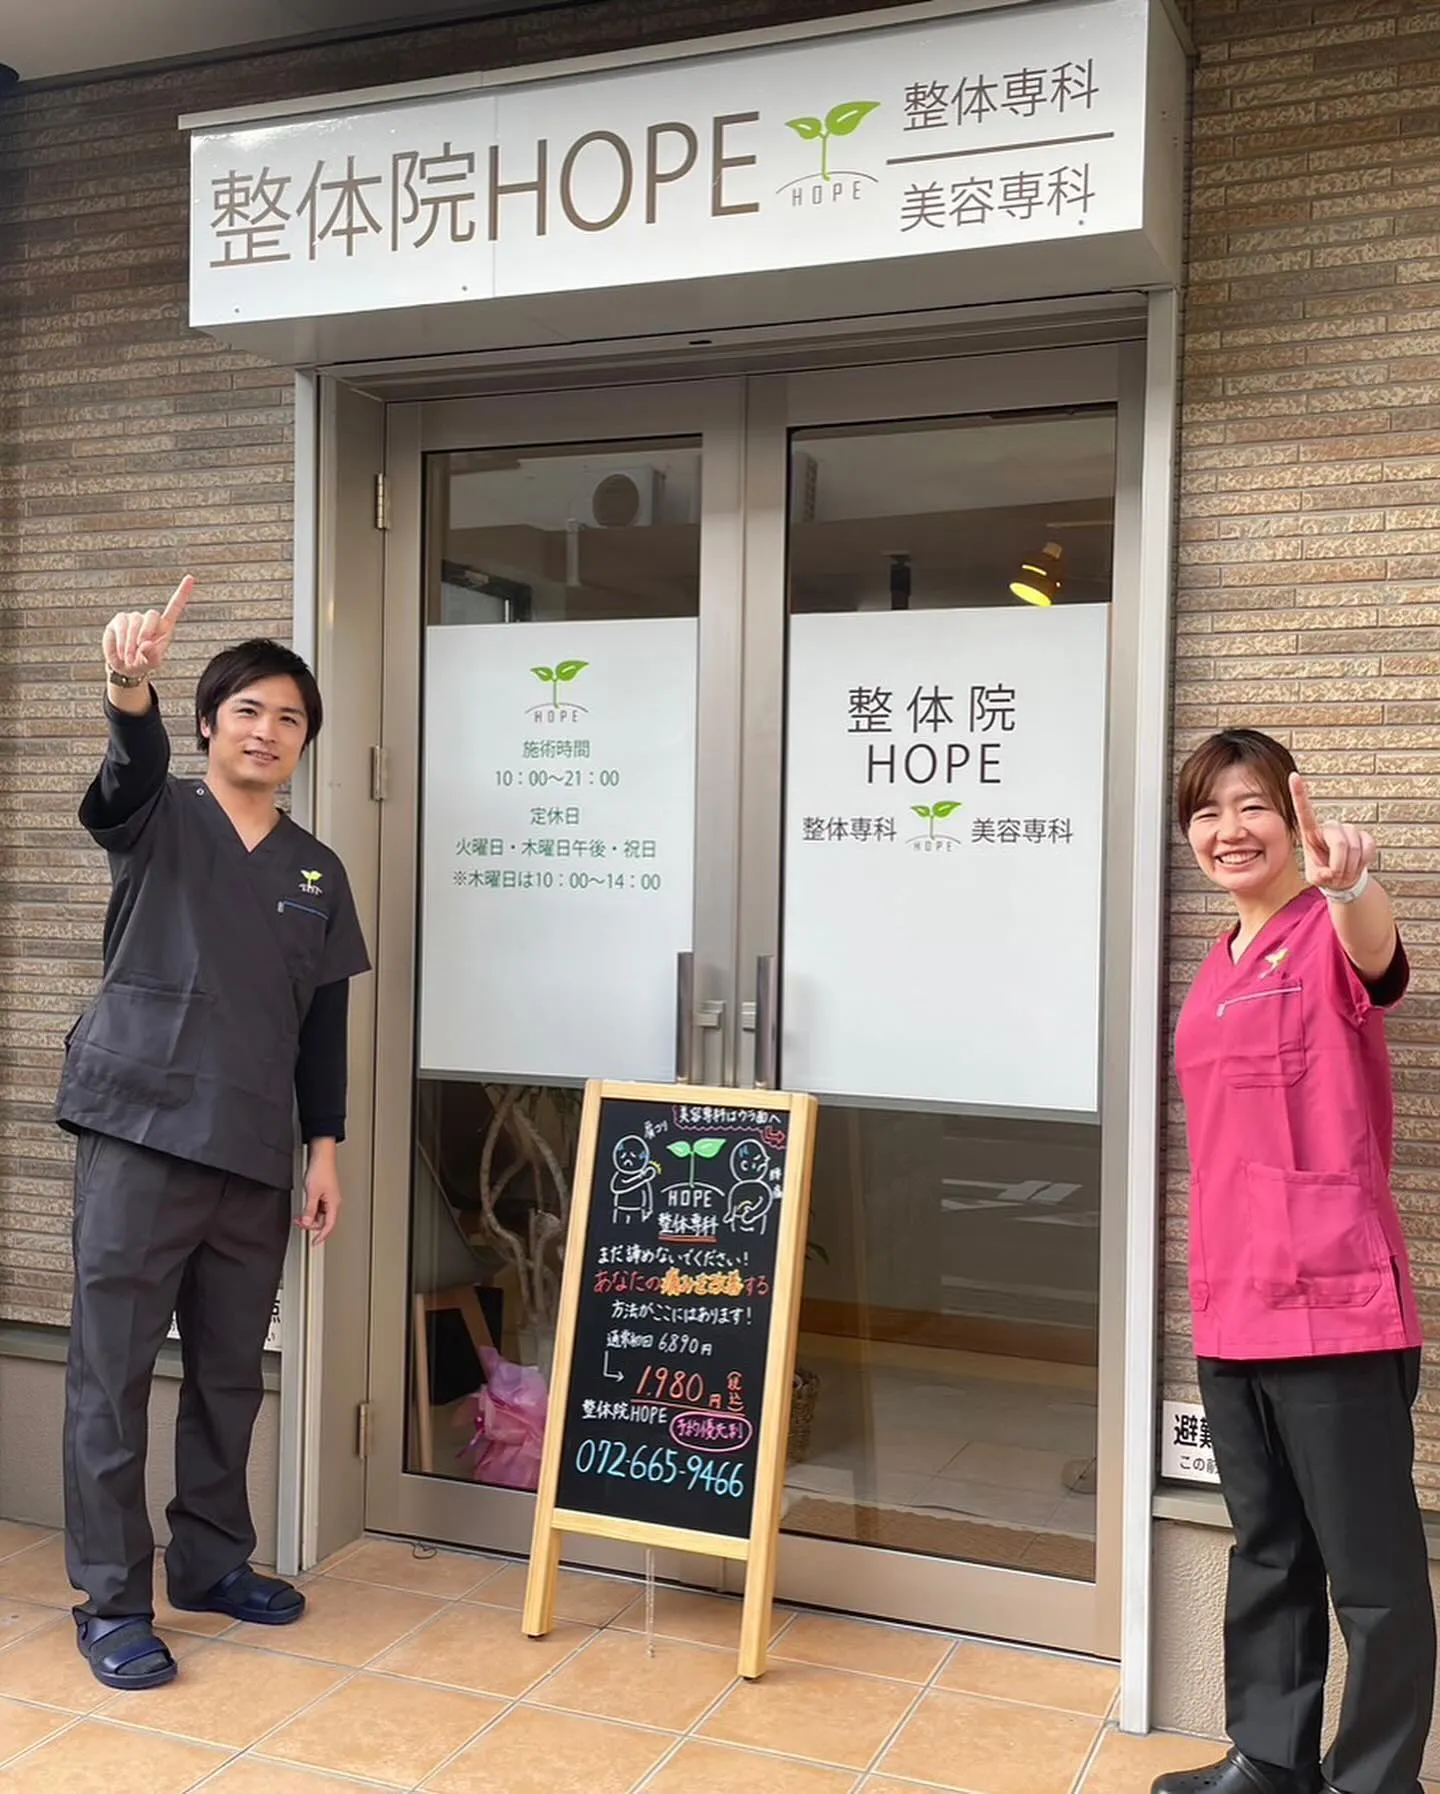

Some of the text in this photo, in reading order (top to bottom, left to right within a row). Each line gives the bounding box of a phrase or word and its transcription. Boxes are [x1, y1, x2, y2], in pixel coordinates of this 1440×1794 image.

[903, 58, 1100, 131] 整体専科
[209, 111, 760, 268] 整体院HOPE
[791, 180, 861, 207] HOPE
[900, 163, 1096, 232] 美容専科
[533, 709, 579, 723] HOPE
[847, 683, 1016, 733] 整体院
[522, 739, 591, 758] 施術時間
[867, 743, 1002, 784] HOPE
[530, 807, 580, 825] 定休日
[802, 816, 897, 842] 整体専科
[971, 817, 1074, 844] 美容専科
[455, 838, 656, 858] 火曜日・木曜日午後・祝日
[913, 841, 953, 853] HOPE
[667, 1189, 713, 1208] HOPE
[658, 1213, 720, 1237] 整体専科
[581, 1398, 668, 1425] 整体院HOPE
[575, 1439, 745, 1498] 072-665-9466
